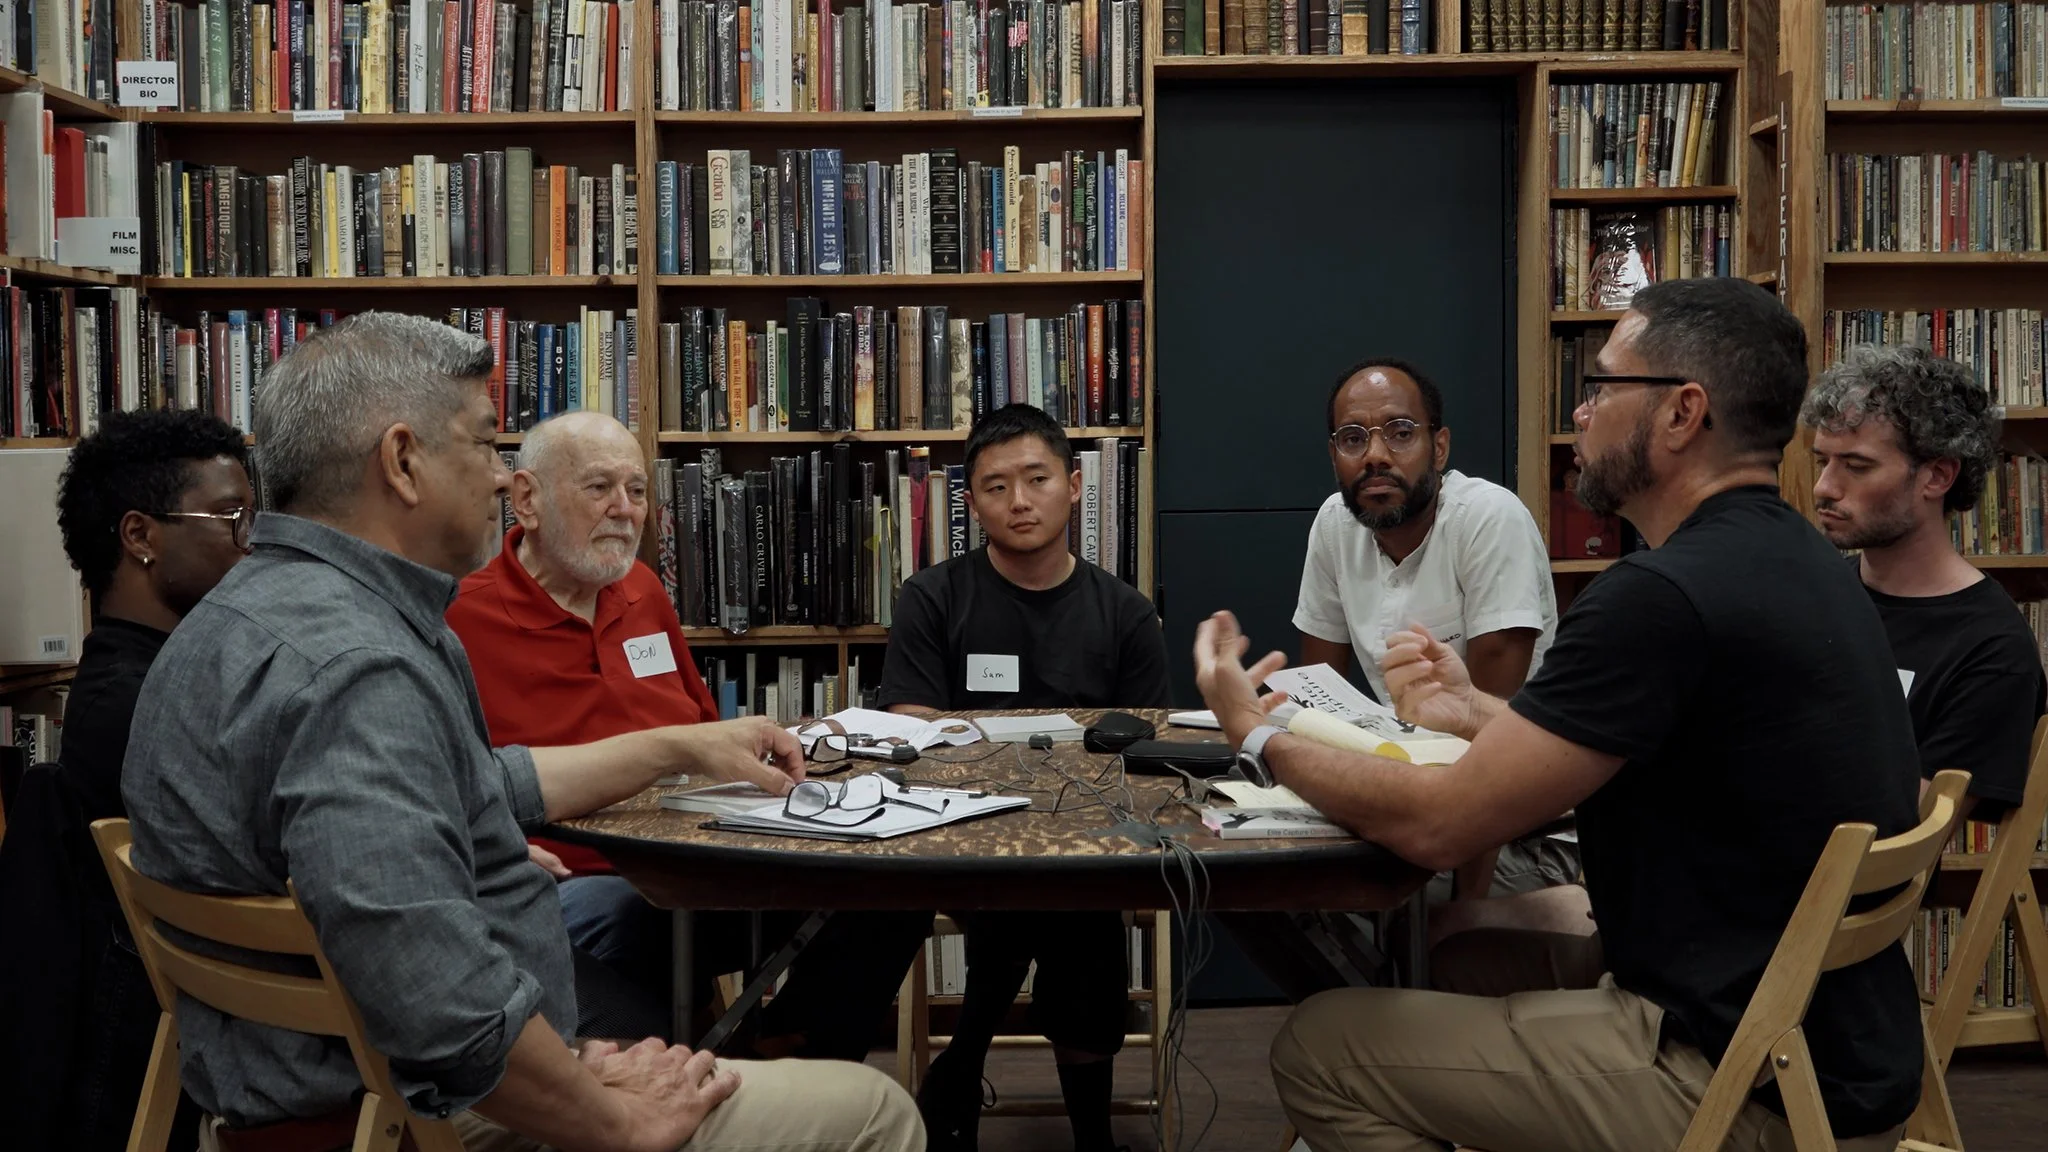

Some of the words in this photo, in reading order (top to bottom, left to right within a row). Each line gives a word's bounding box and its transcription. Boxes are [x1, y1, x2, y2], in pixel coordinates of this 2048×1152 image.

[233, 23, 241, 60] Alexandria
[397, 28, 408, 58] Image
[462, 45, 472, 68] AFTER
[1071, 32, 1082, 75] KOTCH
[231, 63, 241, 91] Quartet
[398, 62, 408, 73] of
[122, 76, 175, 85] DIRECTOR
[398, 76, 408, 98] Hell
[139, 90, 158, 98] BIO
[909, 158, 917, 171] THE
[710, 157, 729, 201] Creation
[1085, 171, 1096, 195] Taking
[625, 195, 636, 210] THE
[660, 167, 672, 217] COUPLES
[1086, 196, 1097, 210] Care
[218, 178, 231, 235] ANGELIQUE
[822, 180, 835, 228] INFINITE
[711, 209, 721, 229] Vidal
[719, 209, 730, 229] Gore
[112, 231, 137, 240] FILM
[625, 236, 637, 249] ON
[823, 233, 836, 257] JEST
[1087, 225, 1096, 251] Williams
[110, 246, 139, 254] MISC.
[470, 312, 482, 331] FAYE
[864, 324, 871, 332] L.
[2031, 320, 2039, 342] DRUMS
[605, 331, 613, 357] BLIND
[626, 316, 637, 356] KOSINSKI
[733, 330, 741, 341] THE
[569, 349, 577, 367] SAVE
[605, 358, 613, 380] DATE
[695, 351, 703, 386] HANYA
[733, 359, 741, 375] WITH
[994, 352, 1002, 371] LAYS
[569, 368, 577, 380] ME
[684, 336, 693, 403] YANAGIHARA
[569, 386, 577, 403] SEAT
[1086, 485, 1097, 531] ROBERT
[756, 505, 764, 540] CARLO
[757, 542, 765, 587] CRIVELLI
[981, 667, 1004, 678] Sam
[1297, 672, 1362, 718] Capture
[1301, 686, 1337, 714] Elite
[1283, 829, 1309, 837] Capture
